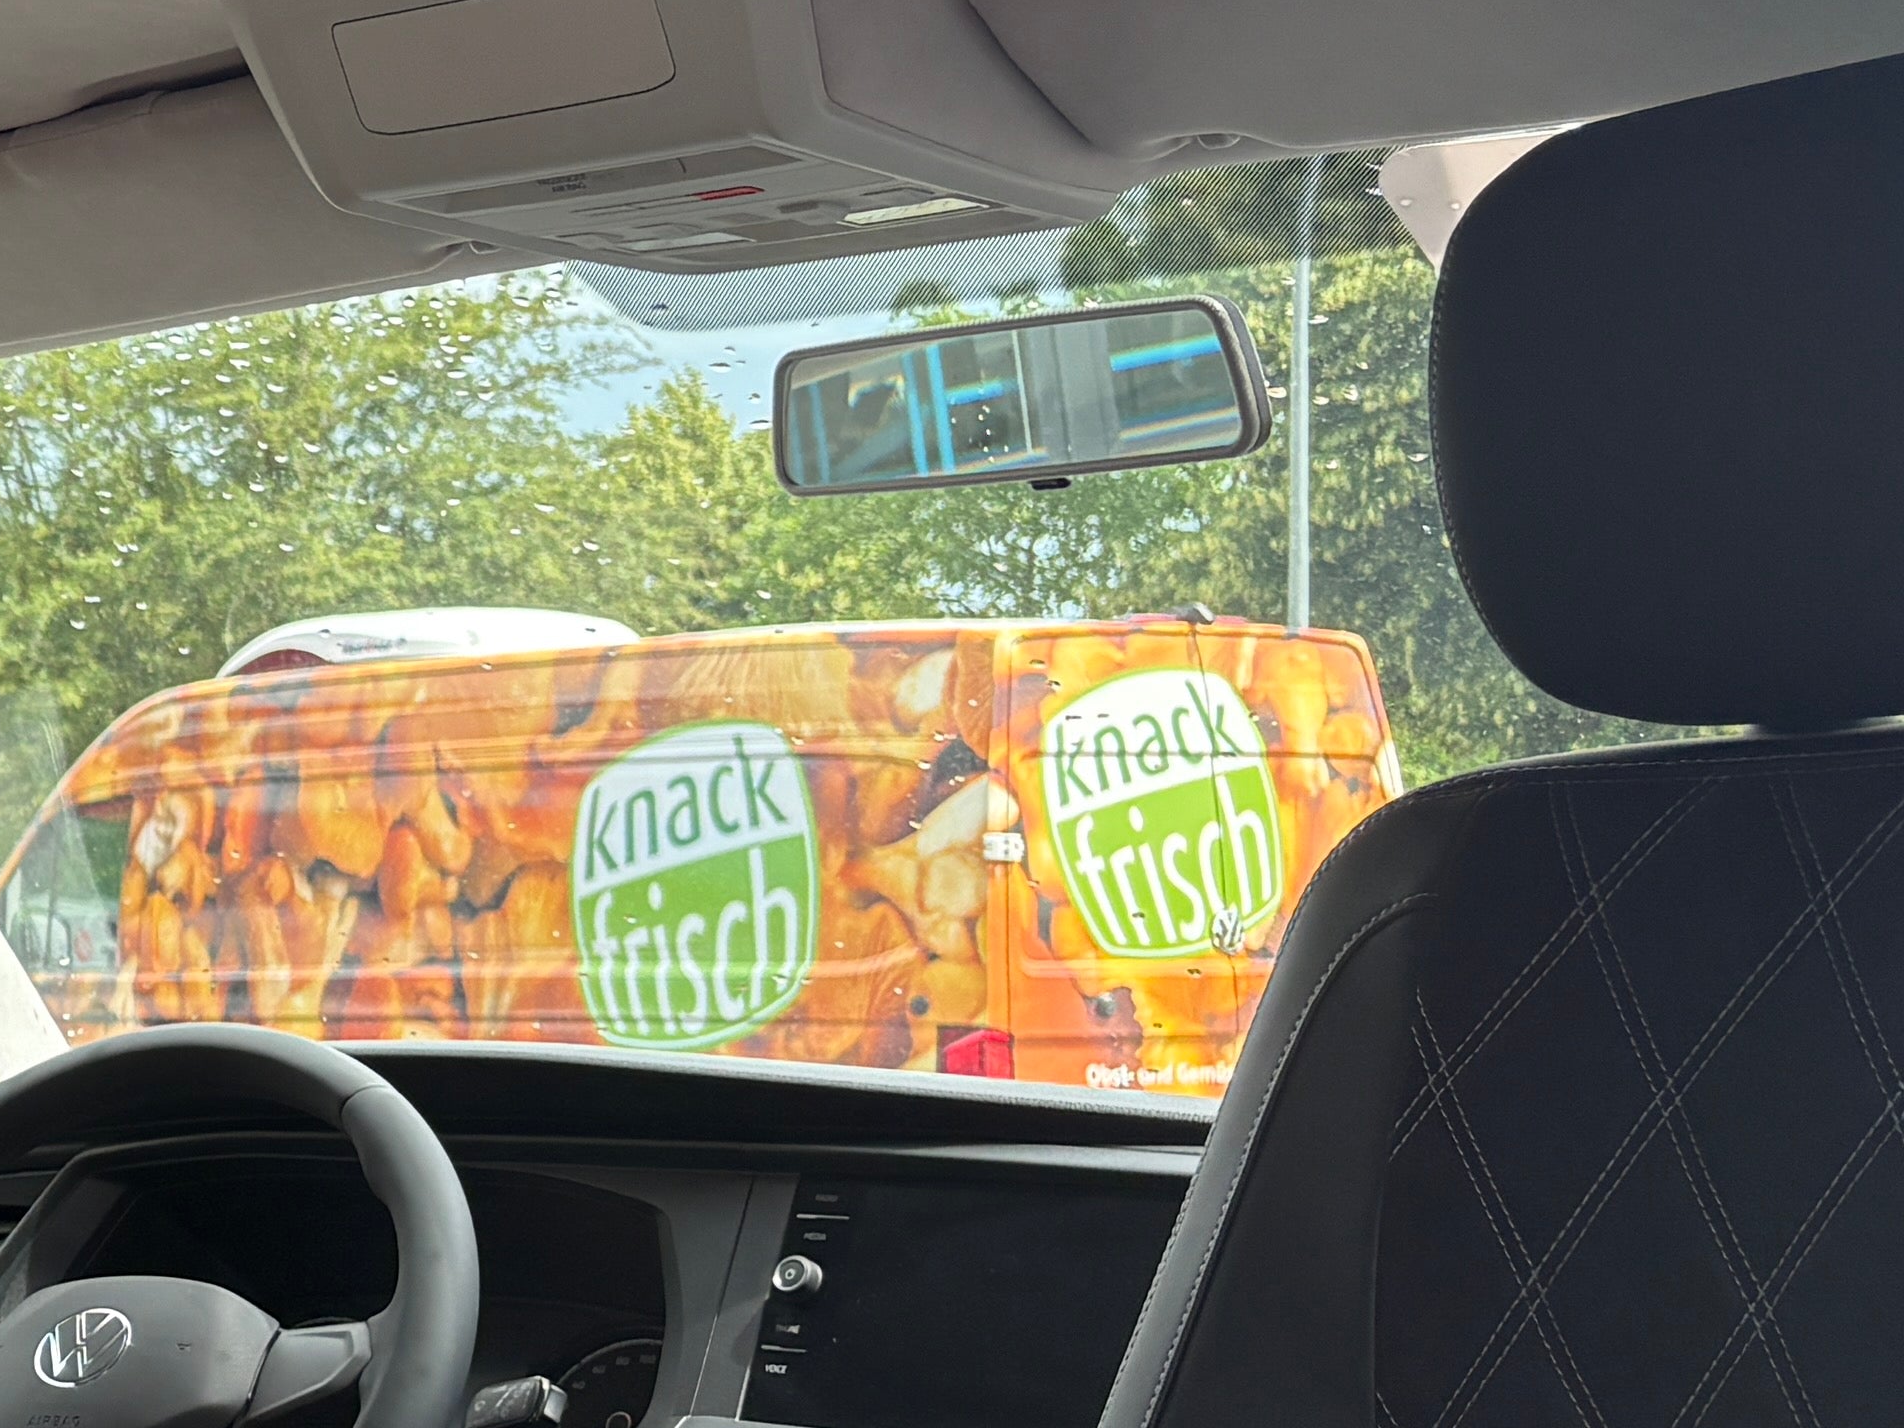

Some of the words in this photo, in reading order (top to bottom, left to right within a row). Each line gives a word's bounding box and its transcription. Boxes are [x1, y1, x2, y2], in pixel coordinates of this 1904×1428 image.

[584, 734, 789, 881] knack
[1054, 678, 1244, 807] knack
[1075, 773, 1273, 946] frisch
[592, 846, 798, 1036] frisch
